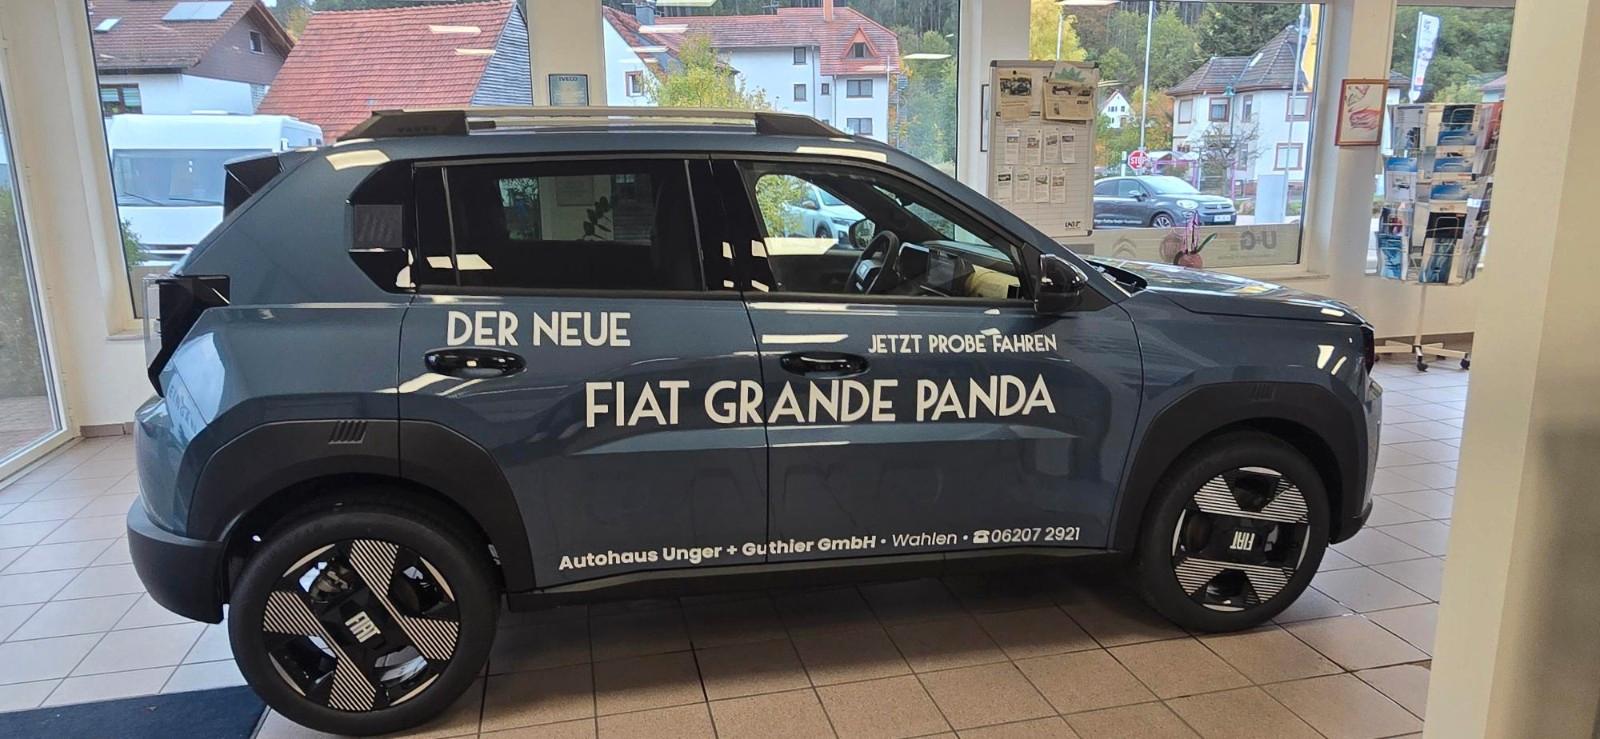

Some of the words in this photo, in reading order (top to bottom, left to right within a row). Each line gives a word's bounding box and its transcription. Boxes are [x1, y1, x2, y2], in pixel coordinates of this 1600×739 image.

[447, 310, 519, 347] DER
[532, 311, 632, 347] NEUE
[868, 334, 922, 354] JETZT
[928, 334, 987, 354] PROBE
[992, 333, 1058, 353] FAHREN
[585, 380, 690, 428] FIAT
[704, 379, 898, 425] GRANDE
[916, 373, 1057, 422] PANDA
[558, 549, 659, 571] Autohaus
[662, 546, 723, 565] Unger
[726, 545, 738, 556] +
[742, 538, 814, 557] Guthier
[817, 535, 877, 551] GmbH
[892, 531, 958, 547] Wahlen
[991, 527, 1042, 544] 06207
[1044, 526, 1081, 541] 2921
[1229, 530, 1256, 551] FIAT
[344, 610, 382, 643] FIAT
